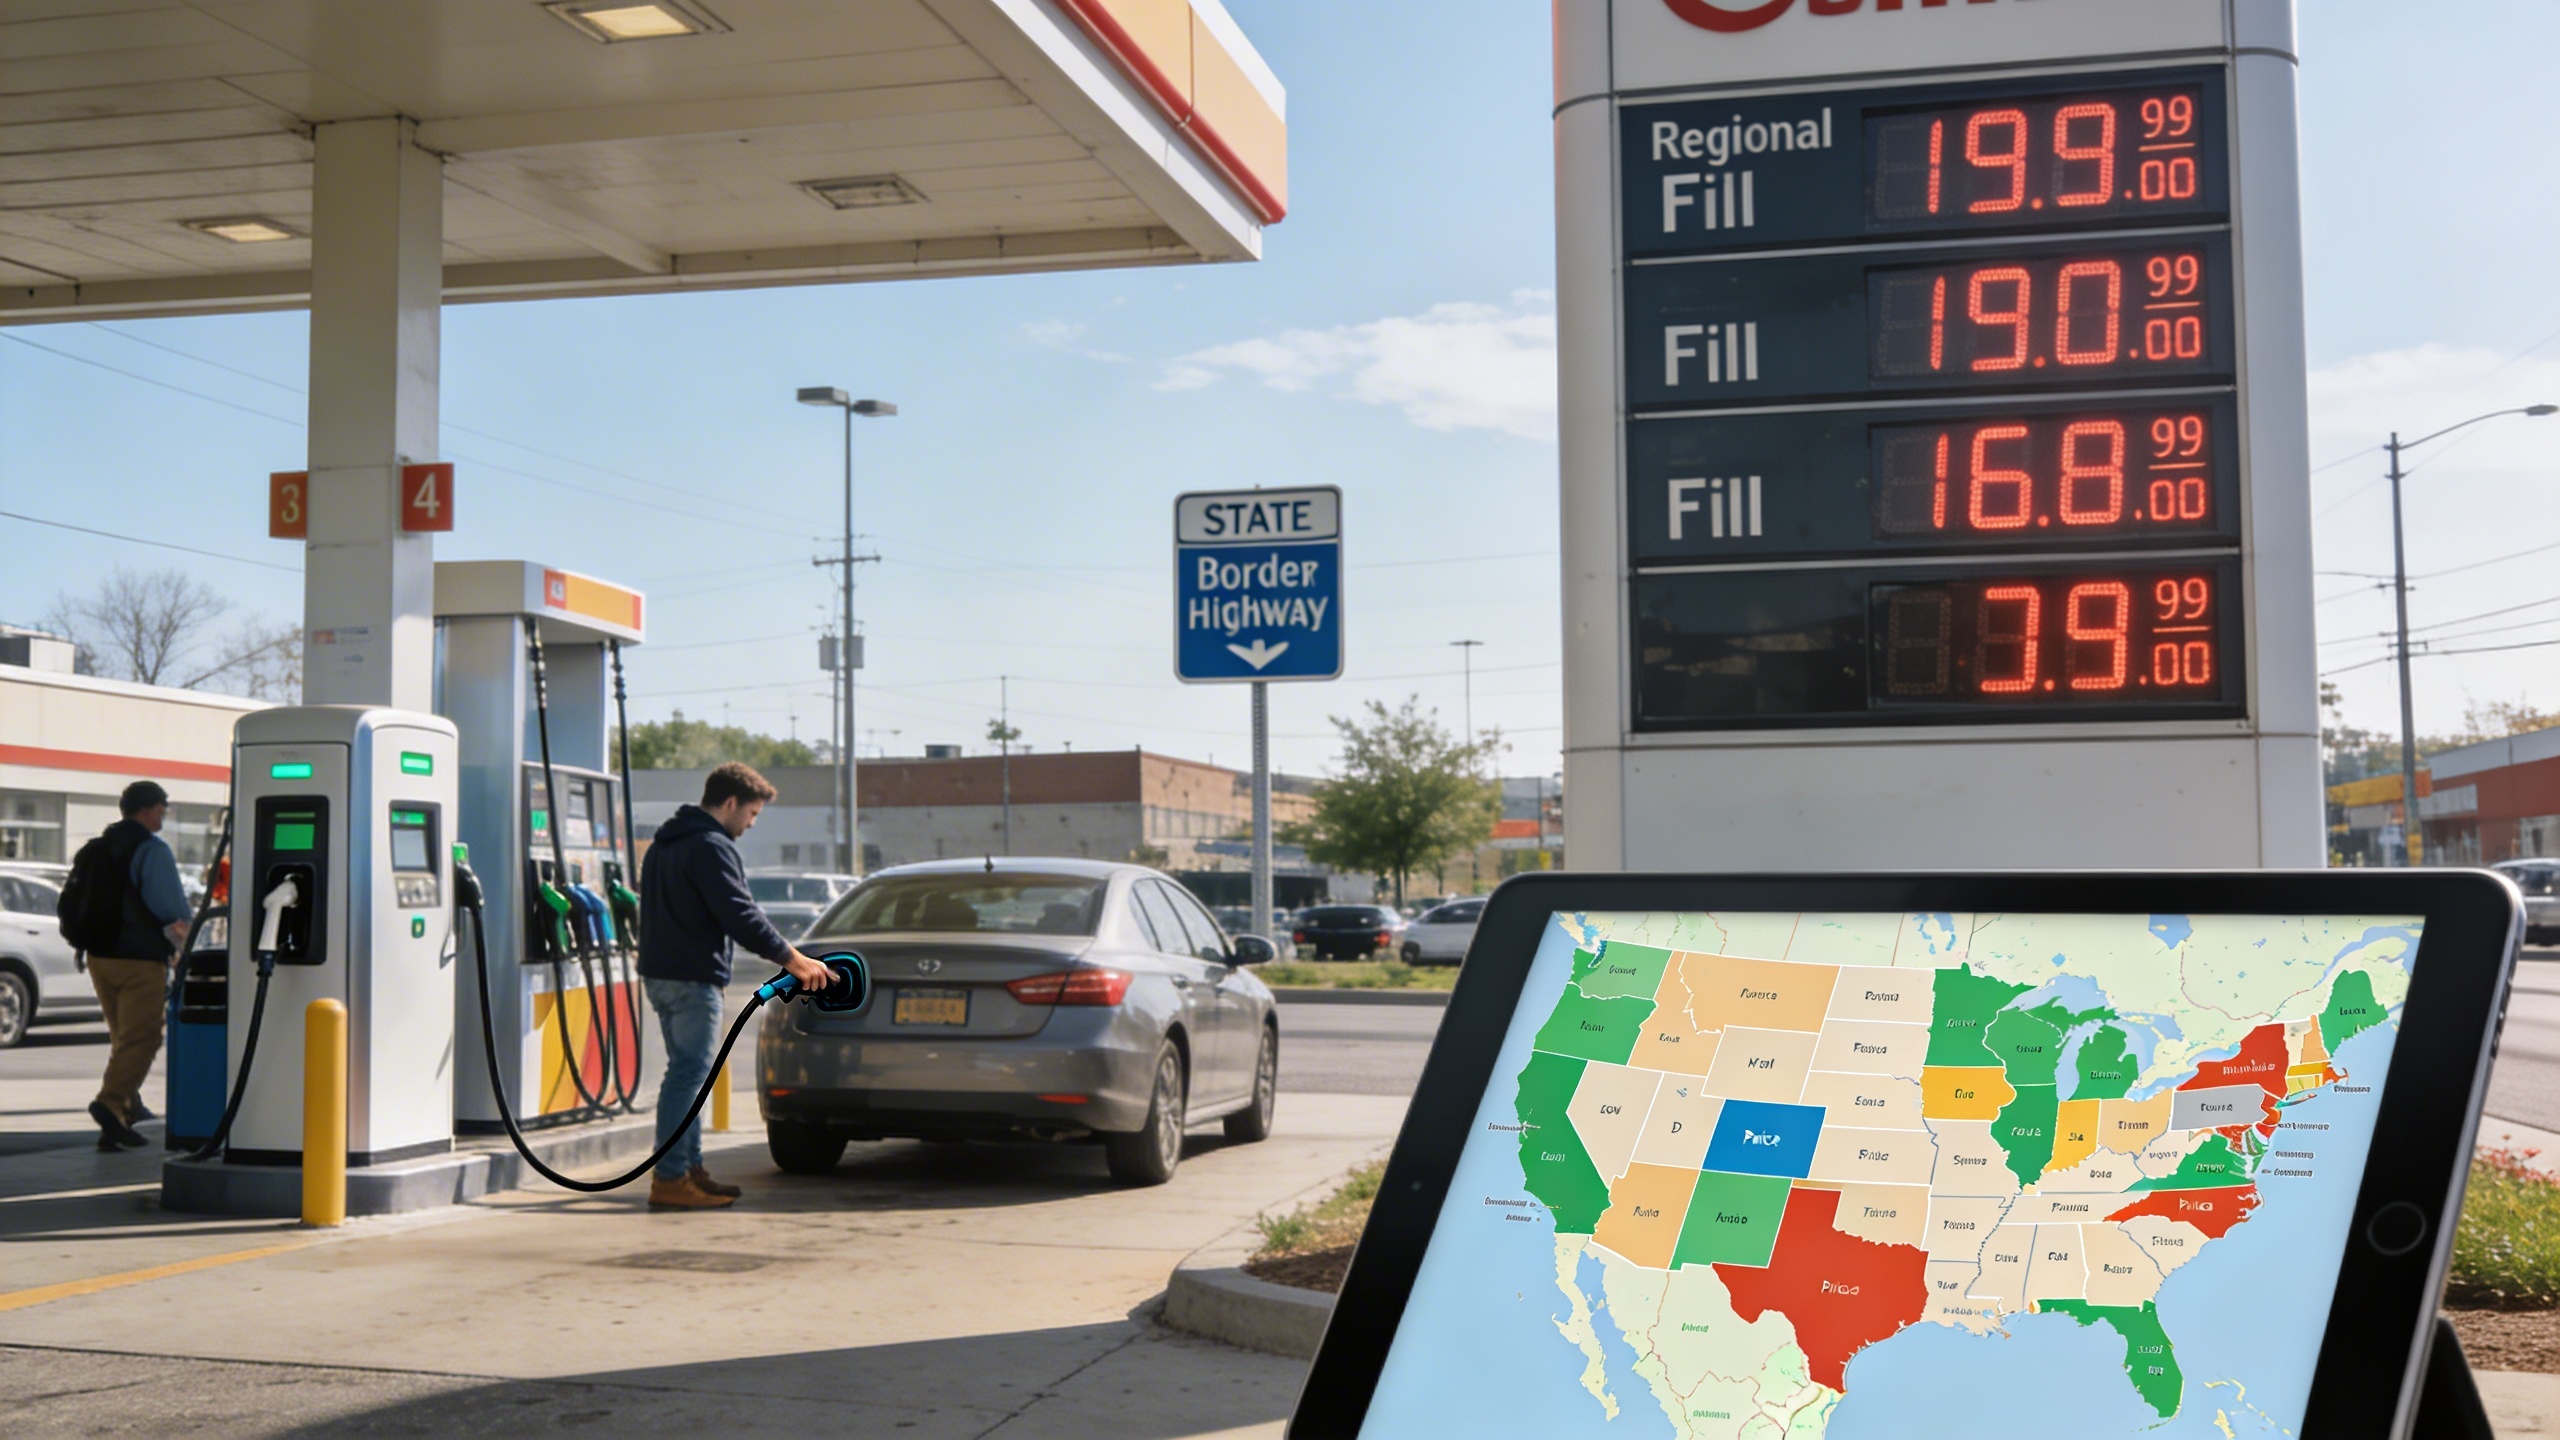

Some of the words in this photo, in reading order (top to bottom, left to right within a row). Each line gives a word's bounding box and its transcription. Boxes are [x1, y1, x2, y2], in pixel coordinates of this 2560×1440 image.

[1652, 108, 1832, 166] Regional
[2141, 96, 2193, 138] 99
[1663, 171, 1754, 233] Fill
[2146, 255, 2199, 298] 99
[1664, 322, 1758, 386] Fill
[2150, 415, 2204, 458] 99
[281, 483, 300, 523] 3
[413, 472, 440, 519] 4
[1668, 475, 1762, 540] Fill
[1204, 500, 1312, 536] STATE
[2154, 578, 2209, 621] 99
